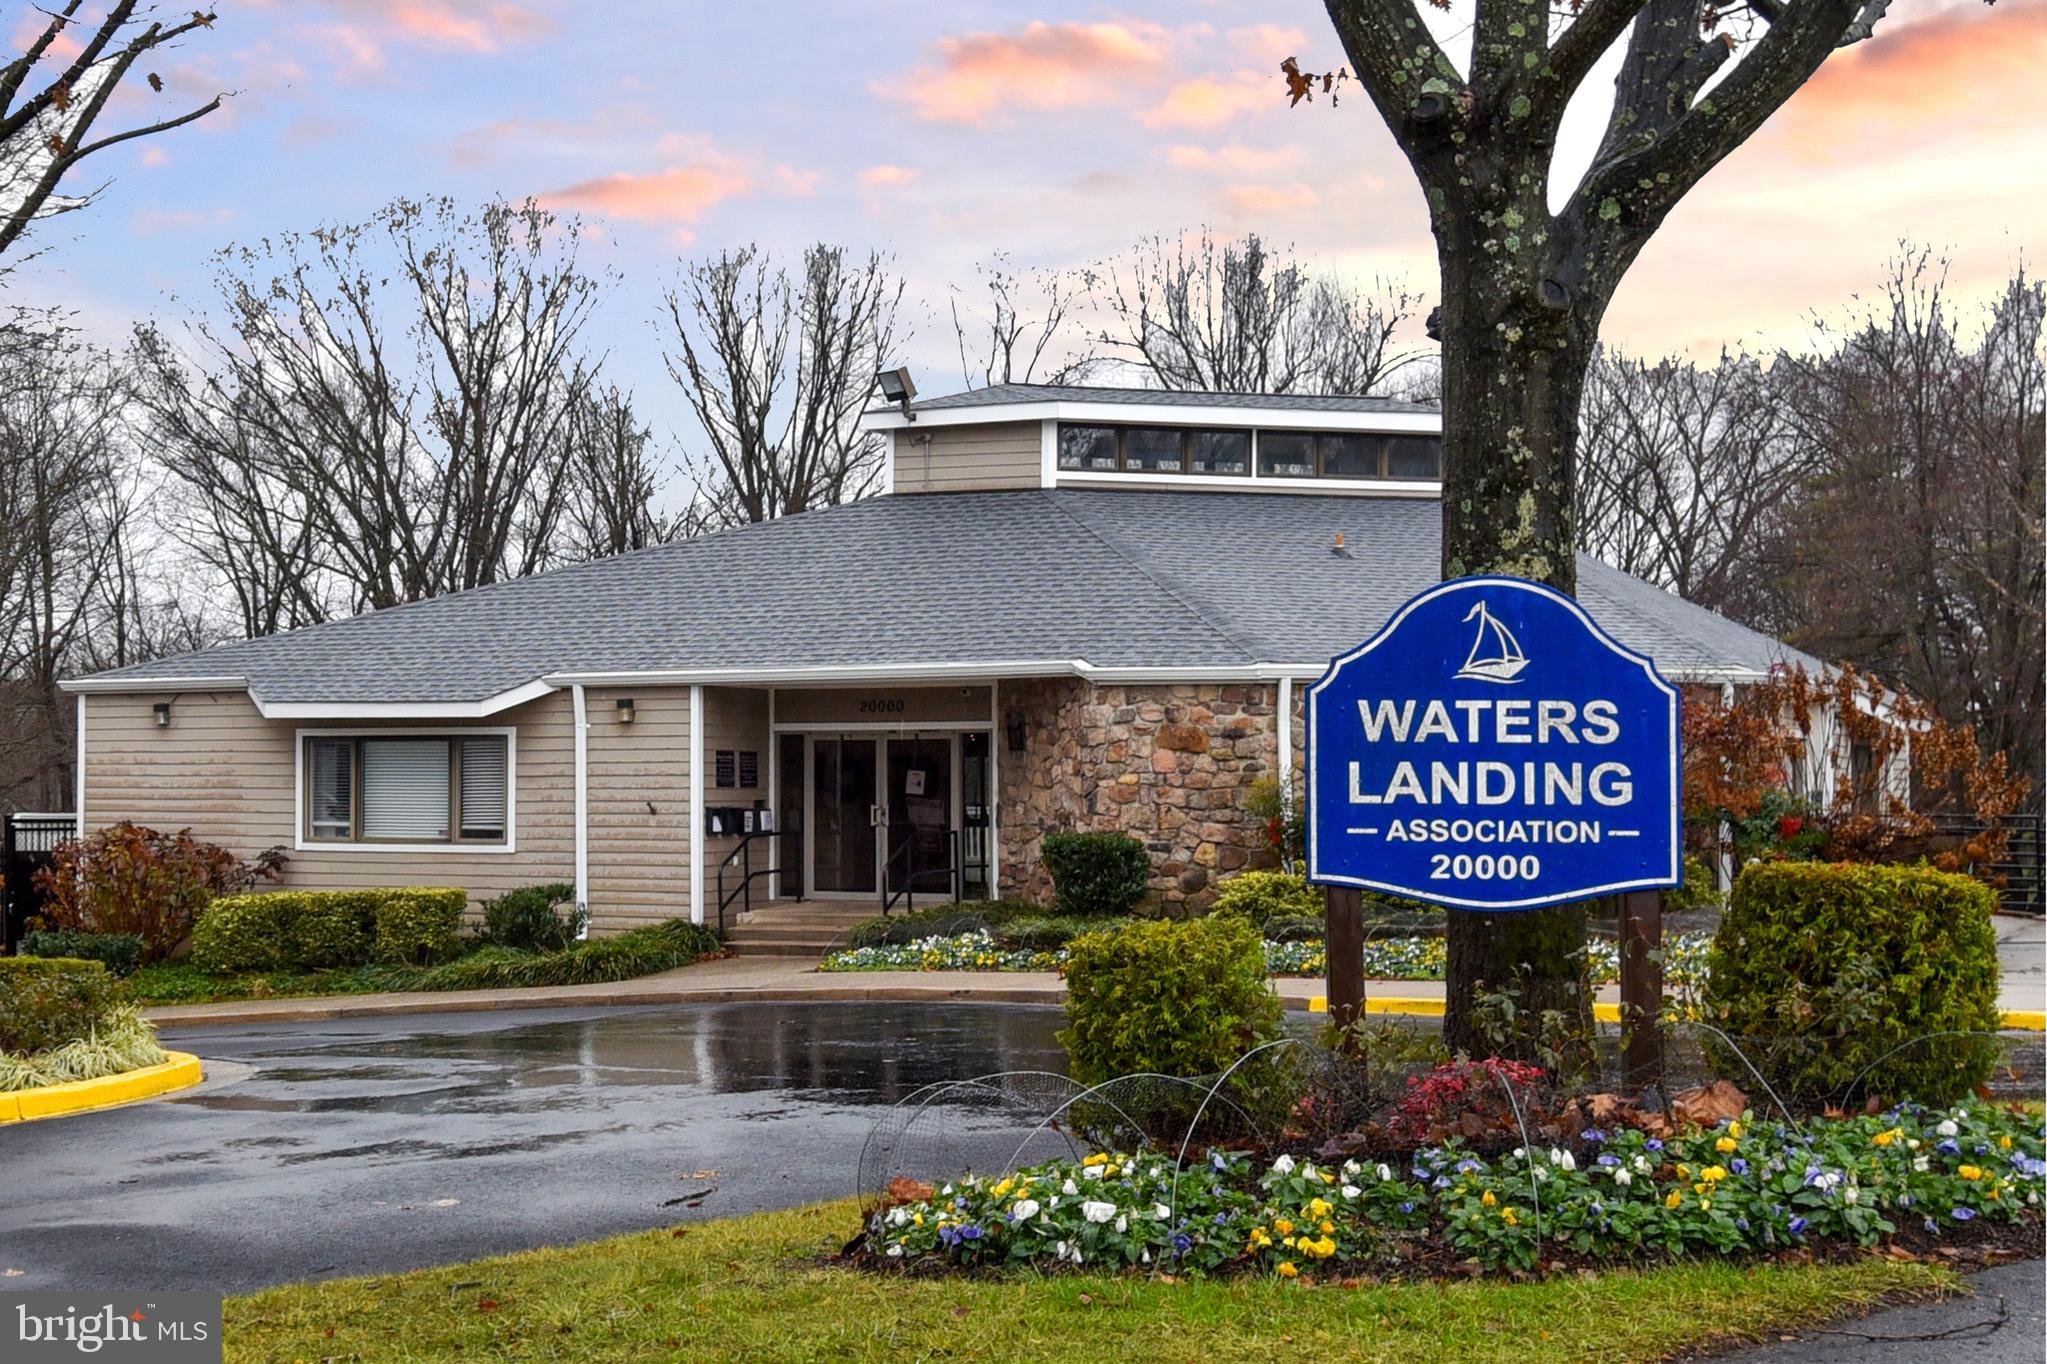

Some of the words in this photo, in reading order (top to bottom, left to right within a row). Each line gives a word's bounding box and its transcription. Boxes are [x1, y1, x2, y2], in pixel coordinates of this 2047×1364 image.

[859, 700, 905, 713] 20000
[1357, 699, 1620, 744] WATERS
[1348, 760, 1634, 807] LANDING
[1385, 819, 1601, 844] ASSOCIATION
[1429, 854, 1541, 881] 20000
